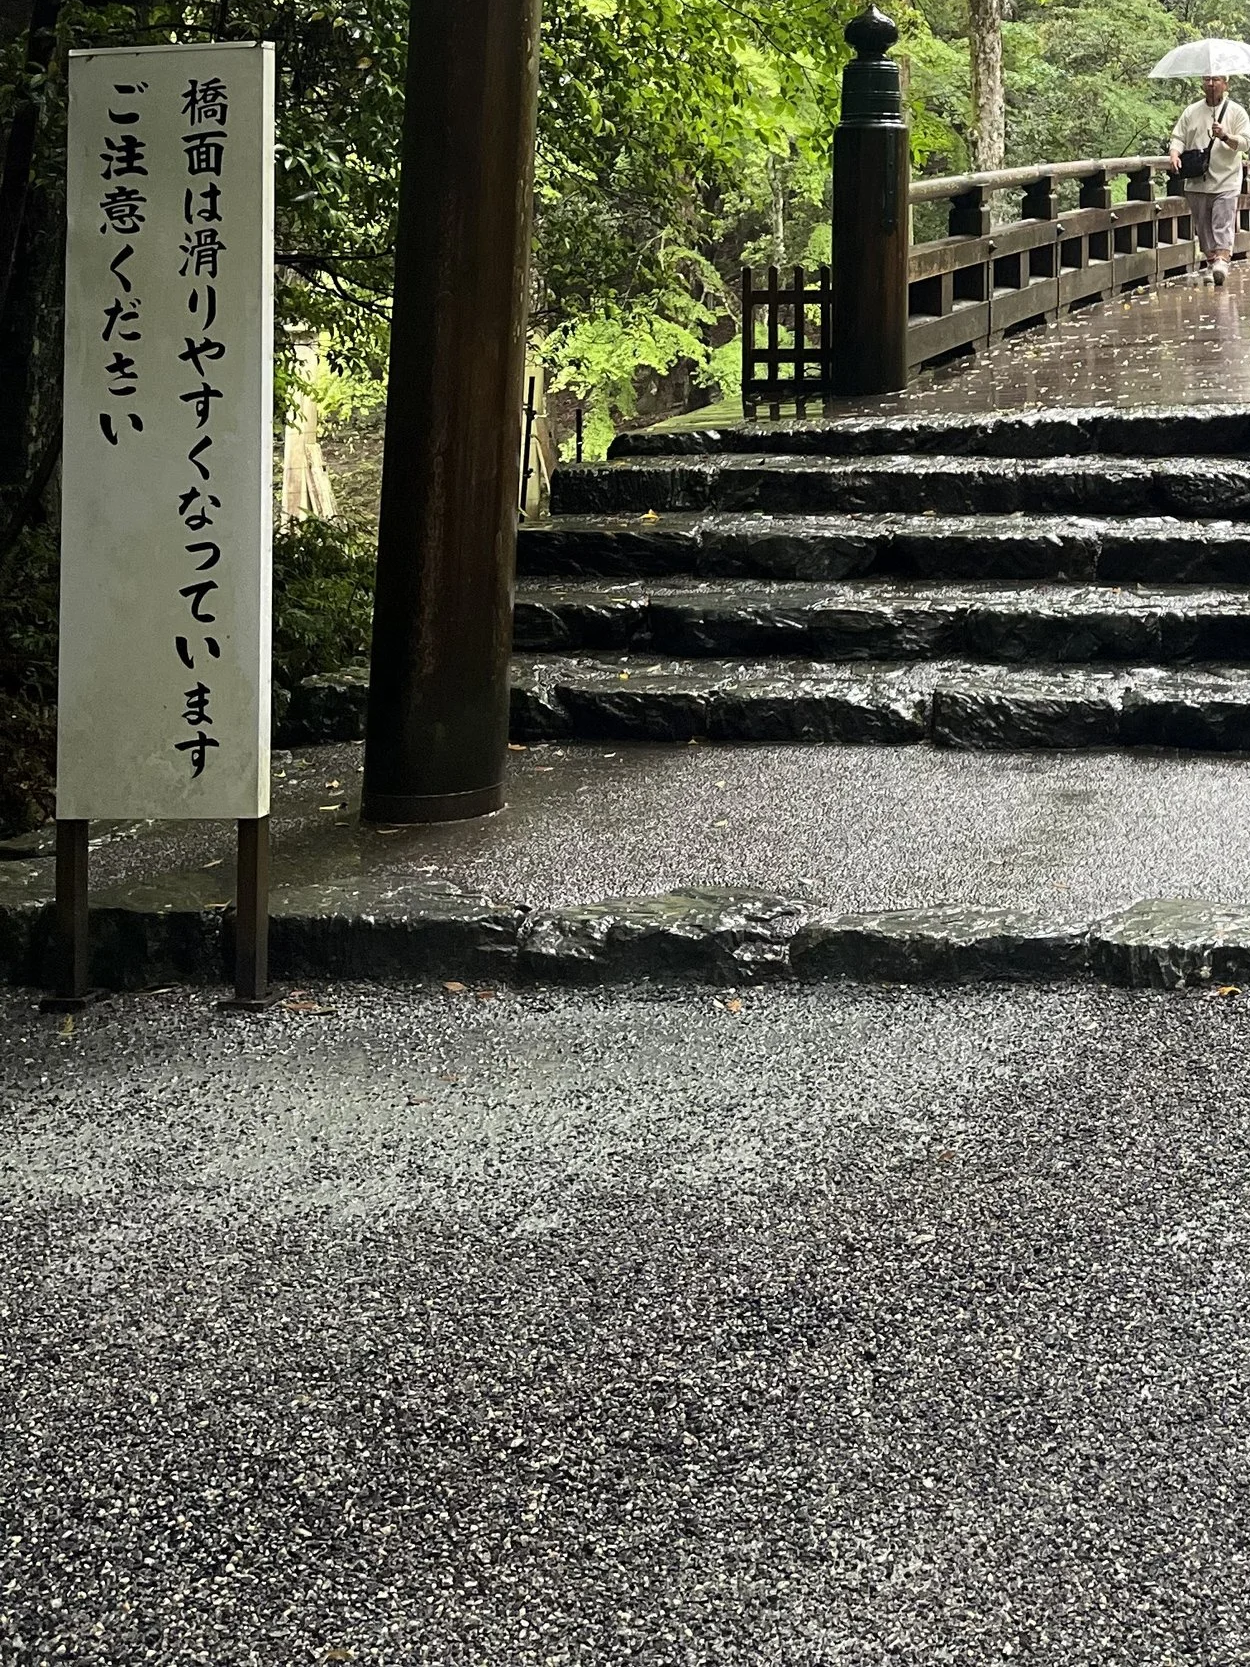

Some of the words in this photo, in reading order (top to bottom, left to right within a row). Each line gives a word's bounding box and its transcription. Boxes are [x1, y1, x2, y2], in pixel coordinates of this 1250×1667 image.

[99, 80, 149, 446] ご注意ください
